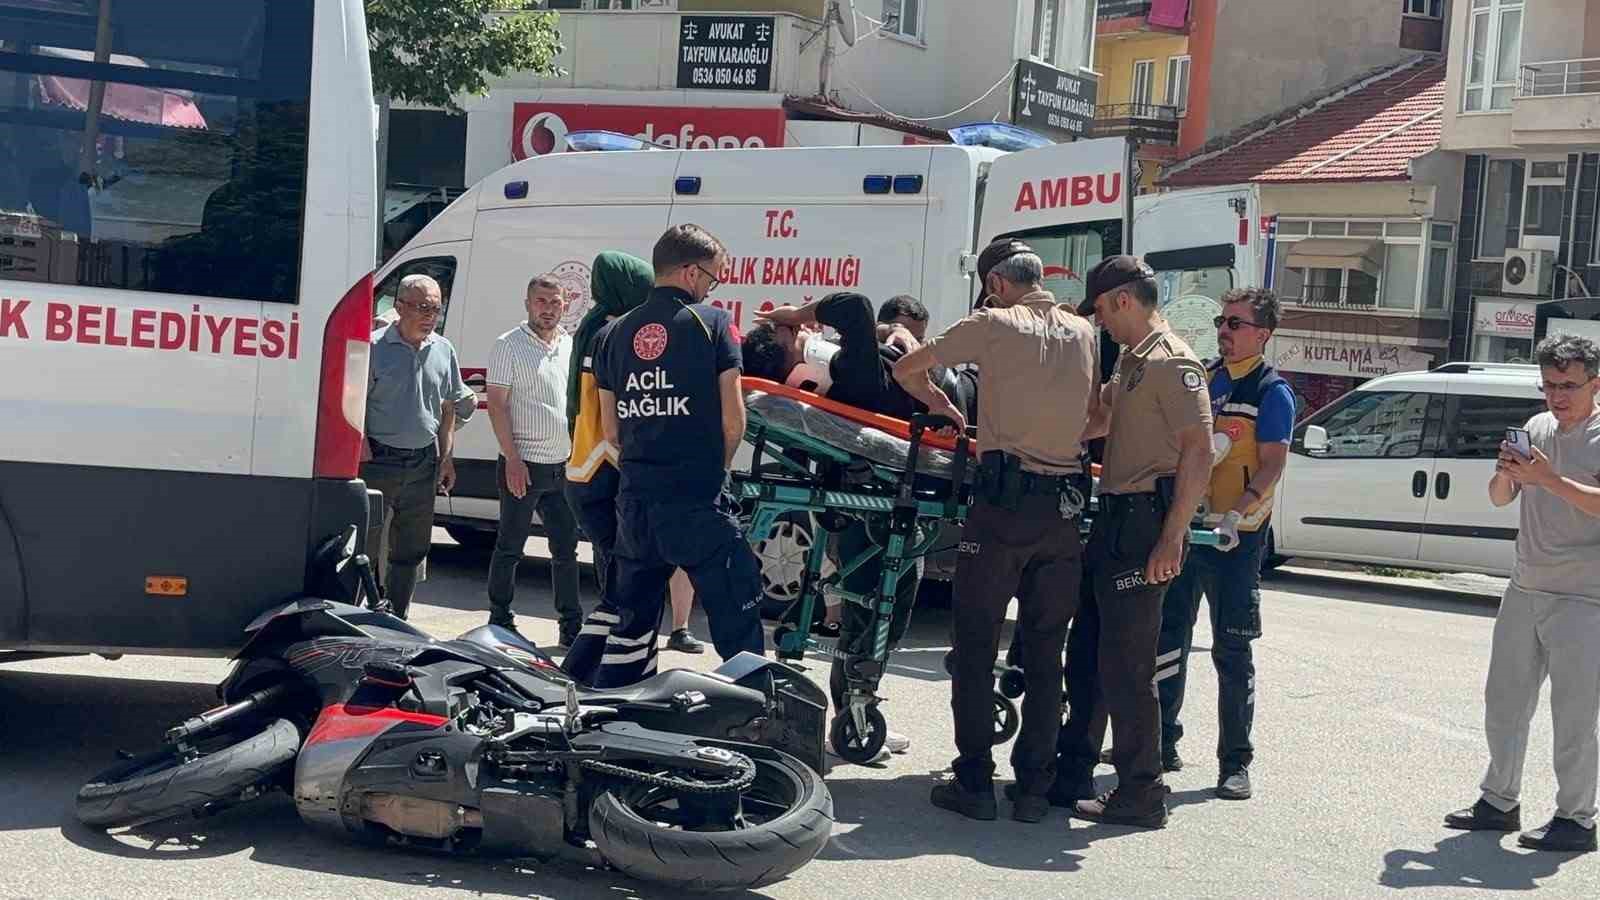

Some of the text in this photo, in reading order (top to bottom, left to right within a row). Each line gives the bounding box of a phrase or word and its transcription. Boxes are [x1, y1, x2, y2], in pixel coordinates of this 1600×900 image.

[709, 23, 745, 40] AVUKAT
[683, 43, 769, 64] TAYFUN KARAOĞLU
[693, 67, 757, 85] 0536 050 46 85
[1056, 76, 1081, 95] AVUKAT
[1037, 89, 1062, 110] TAYFUN
[636, 123, 765, 150] dafone
[1014, 172, 1121, 212] AMBU
[765, 209, 798, 238] T.C.
[762, 254, 861, 287] BAKANLIĞI
[45, 302, 300, 360] BELEDİYESİ
[1304, 345, 1373, 368] KUTLAMA
[625, 366, 674, 391] ACİL
[617, 393, 690, 419] SAĞLIK
